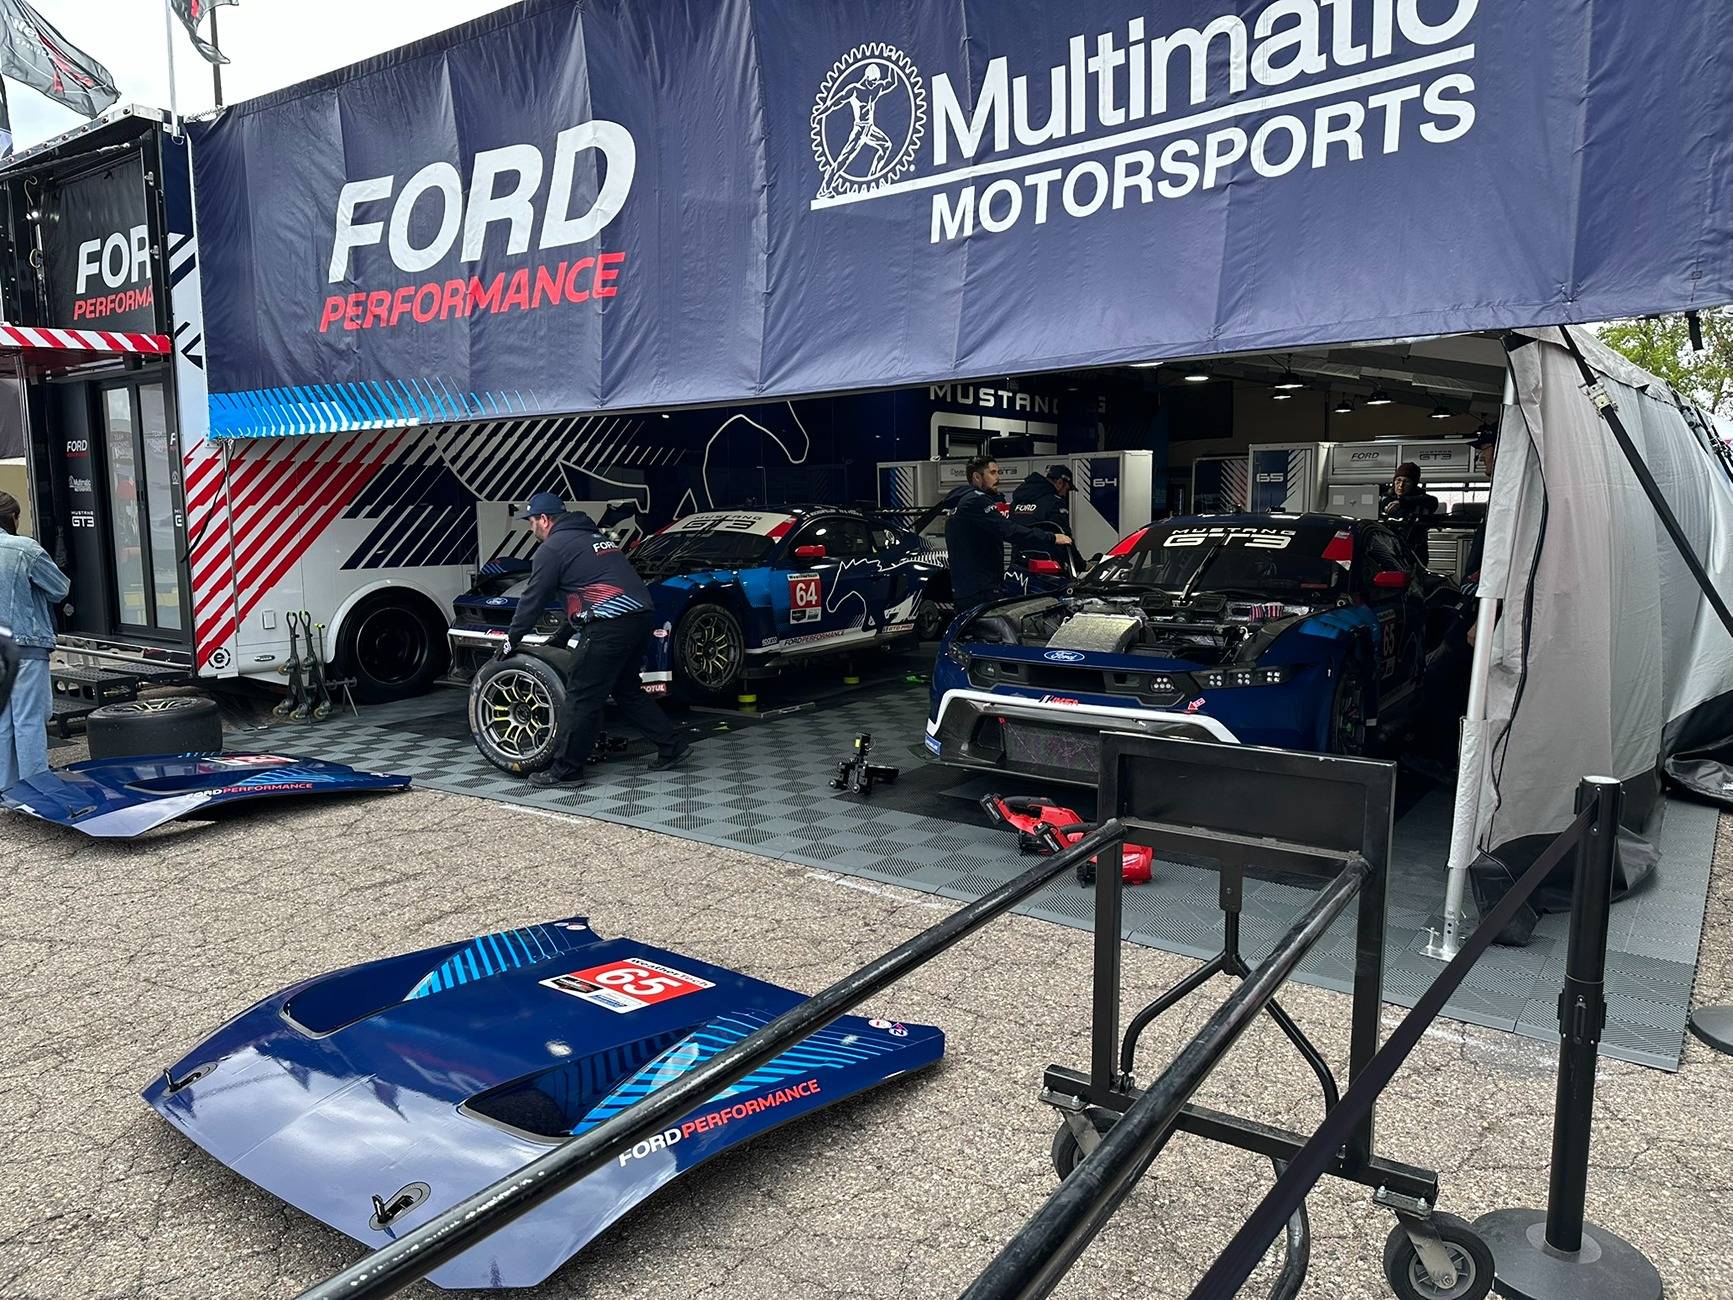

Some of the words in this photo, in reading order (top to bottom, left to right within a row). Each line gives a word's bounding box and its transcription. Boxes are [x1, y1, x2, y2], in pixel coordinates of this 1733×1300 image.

[929, 73, 1477, 244] MOTORSPORTS
[328, 119, 637, 284] FORD
[319, 252, 627, 333] PERFORMANCE
[66, 439, 88, 453] FORD
[1351, 451, 1380, 461] FORD
[1092, 477, 1118, 487] 64
[1256, 473, 1285, 483] 65
[1015, 503, 1037, 512] FORD
[71, 516, 95, 528] GT3
[1172, 527, 1296, 536] MUSTANG
[1162, 533, 1293, 550] GT3
[796, 582, 817, 607] 64
[594, 967, 684, 996] 65
